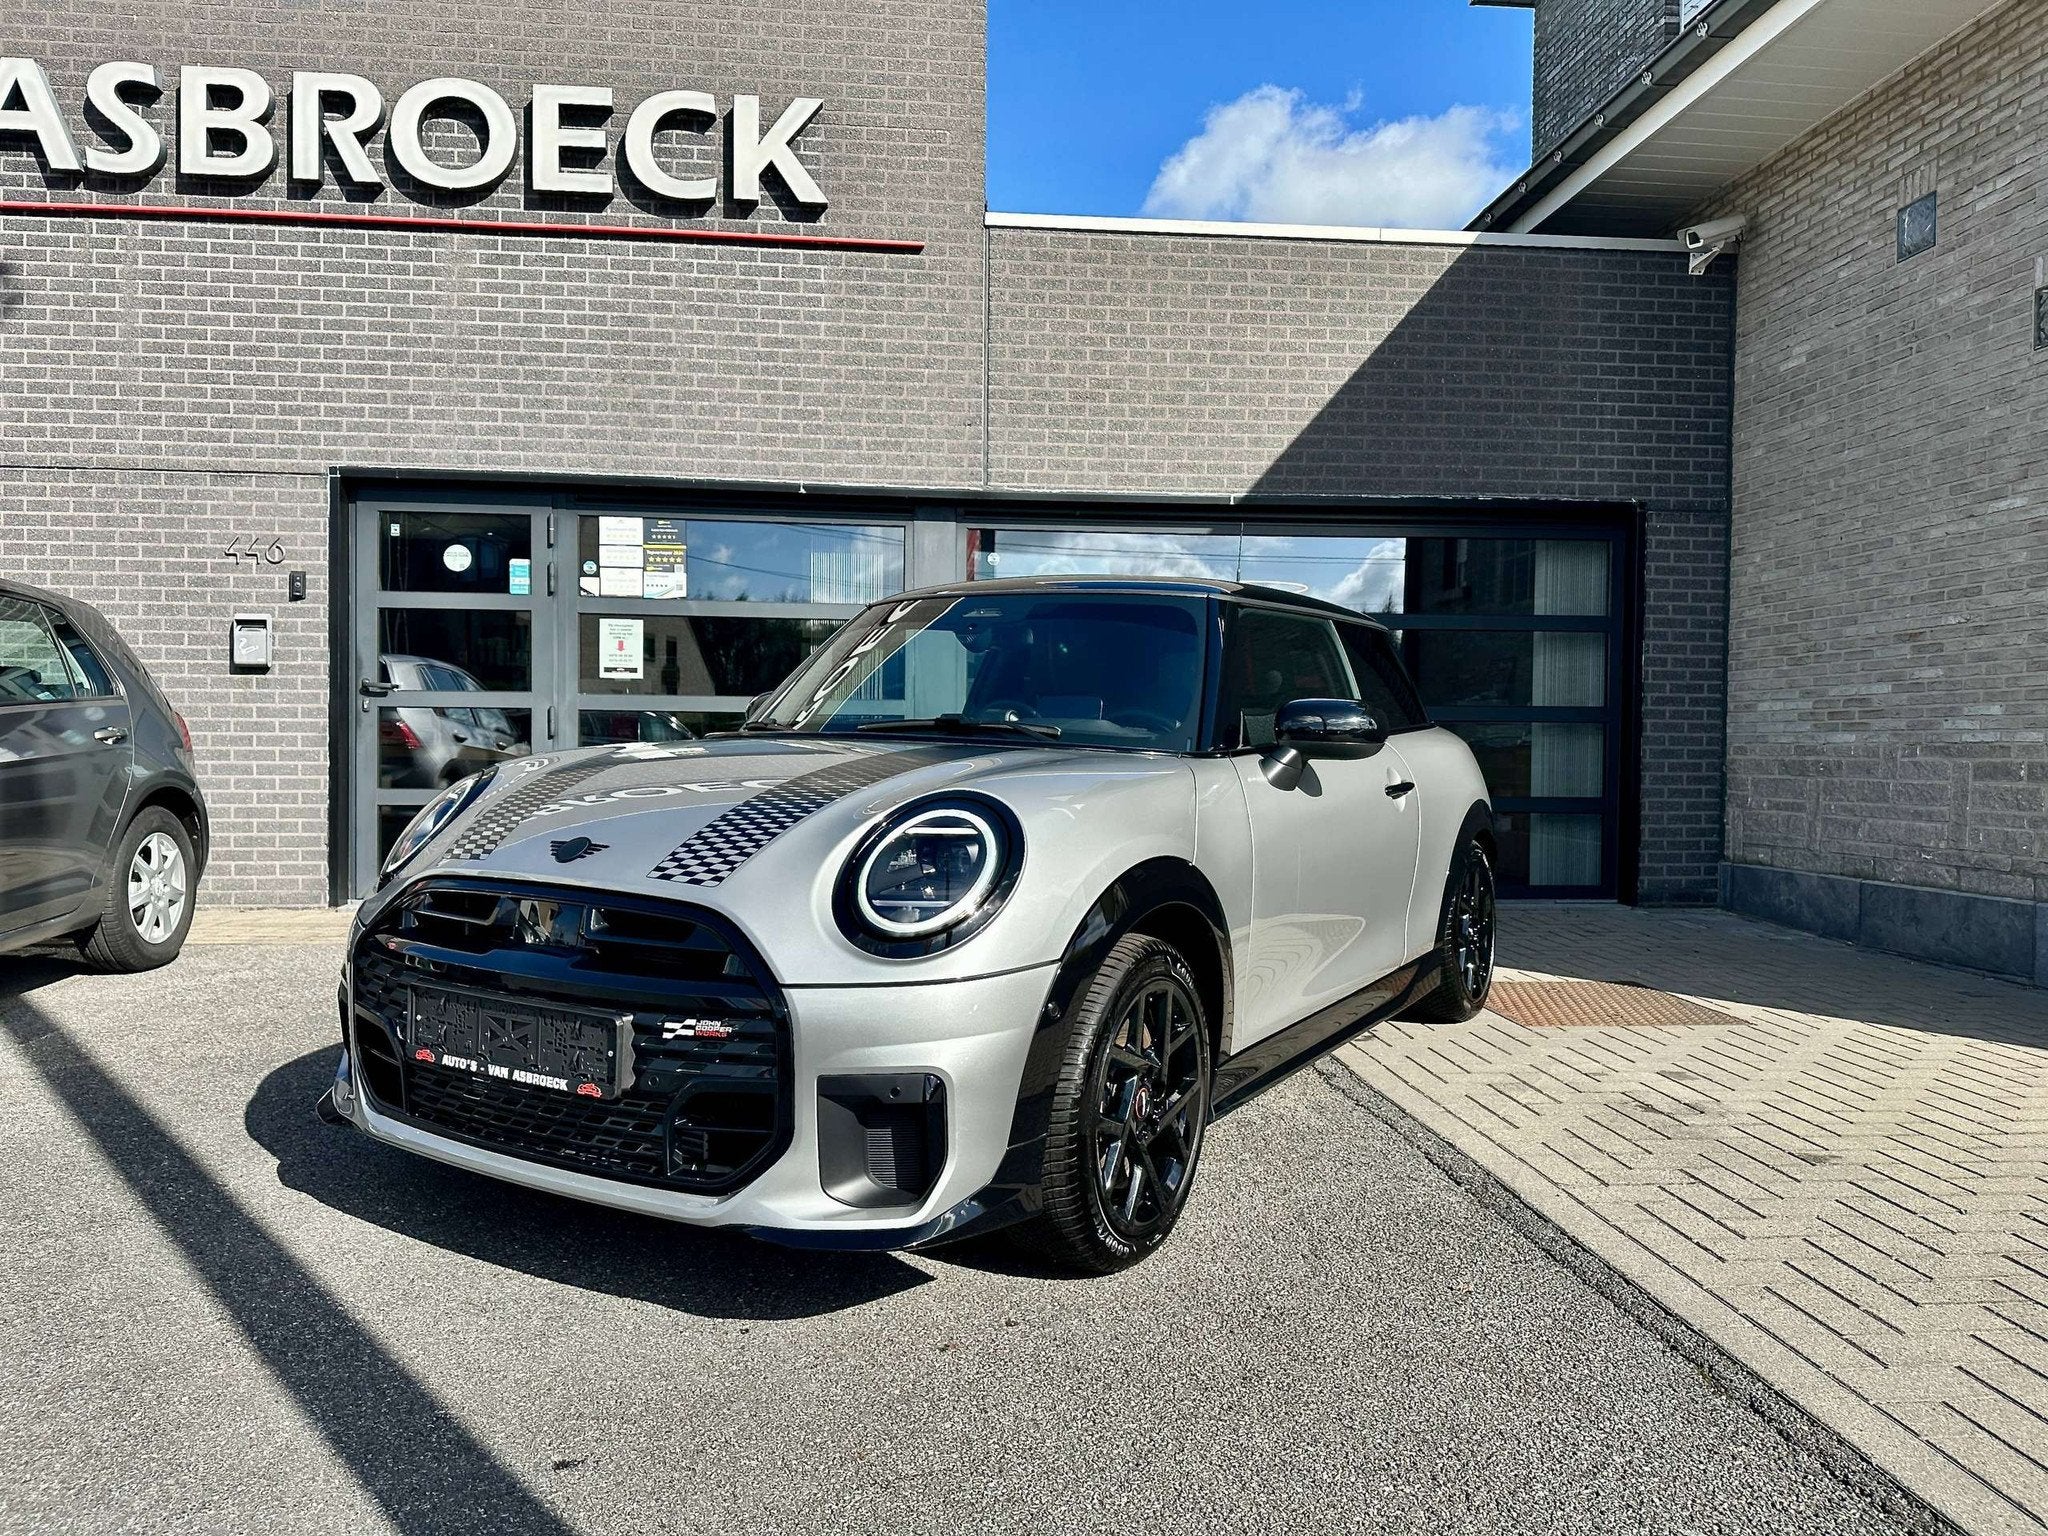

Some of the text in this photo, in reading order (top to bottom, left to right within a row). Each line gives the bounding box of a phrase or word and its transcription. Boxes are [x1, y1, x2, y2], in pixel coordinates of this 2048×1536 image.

[0, 57, 829, 206] ASBROECK
[224, 536, 286, 565] 446
[695, 1025, 733, 1033] COOPER
[695, 1030, 728, 1038] WORKS
[441, 1054, 478, 1072] AUTO'S
[487, 1063, 510, 1080] VAN
[512, 1069, 569, 1092] ASBROECK
